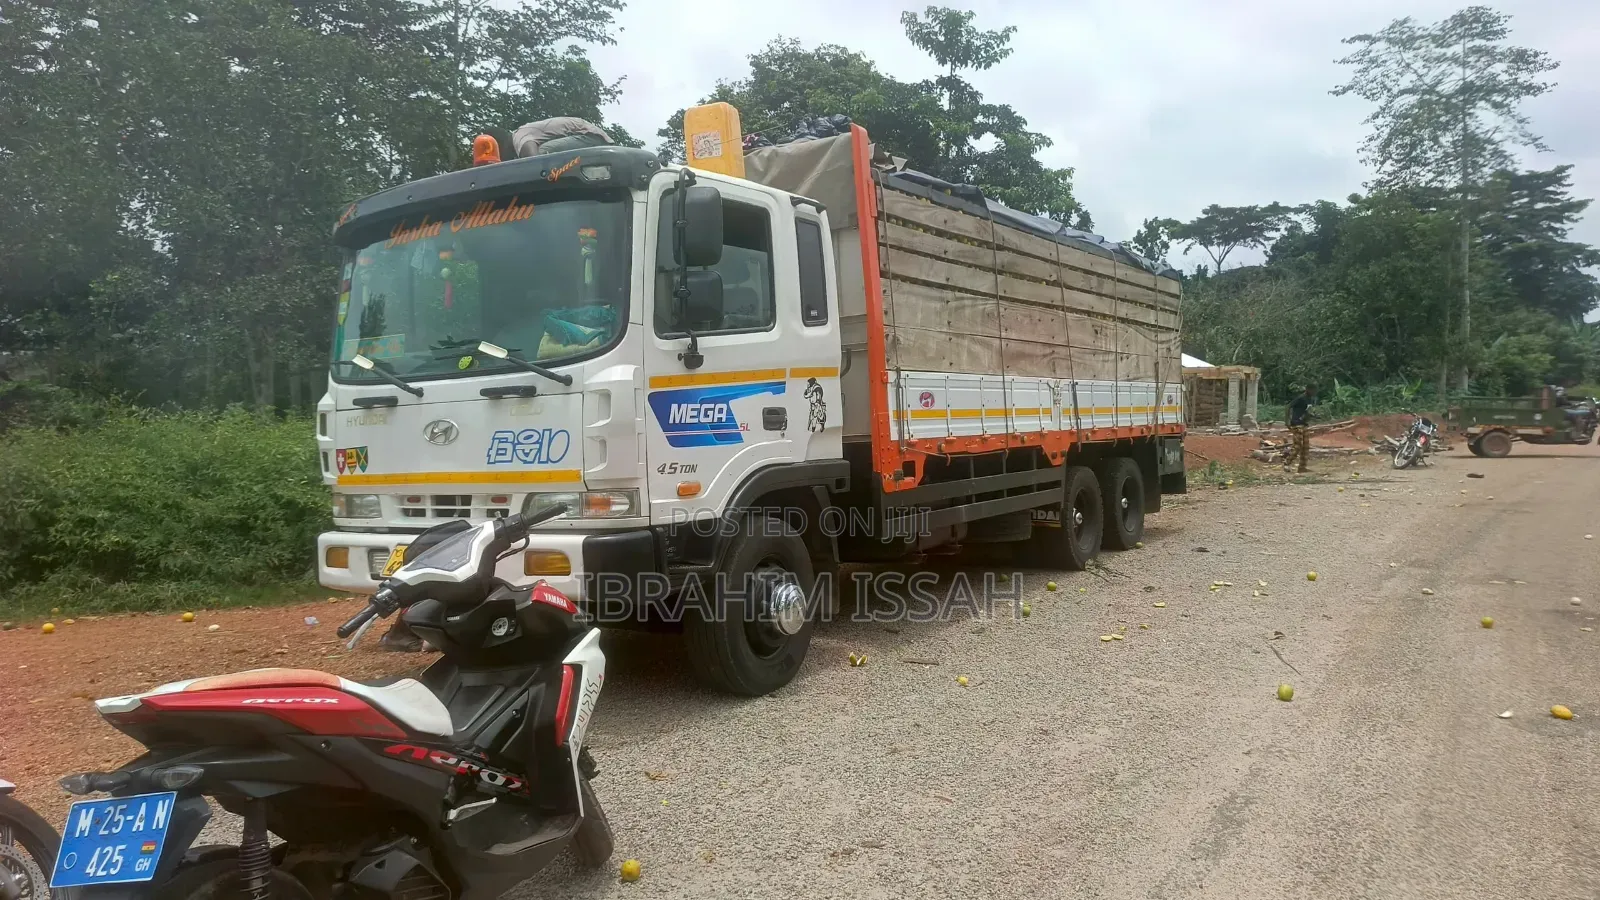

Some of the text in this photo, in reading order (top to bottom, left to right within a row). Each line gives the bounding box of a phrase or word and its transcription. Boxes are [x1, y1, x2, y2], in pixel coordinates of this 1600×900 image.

[668, 403, 728, 424] MEGA
[679, 463, 698, 474] TON
[543, 592, 568, 609] YAMAHA
[85, 844, 152, 877] 425 GH
